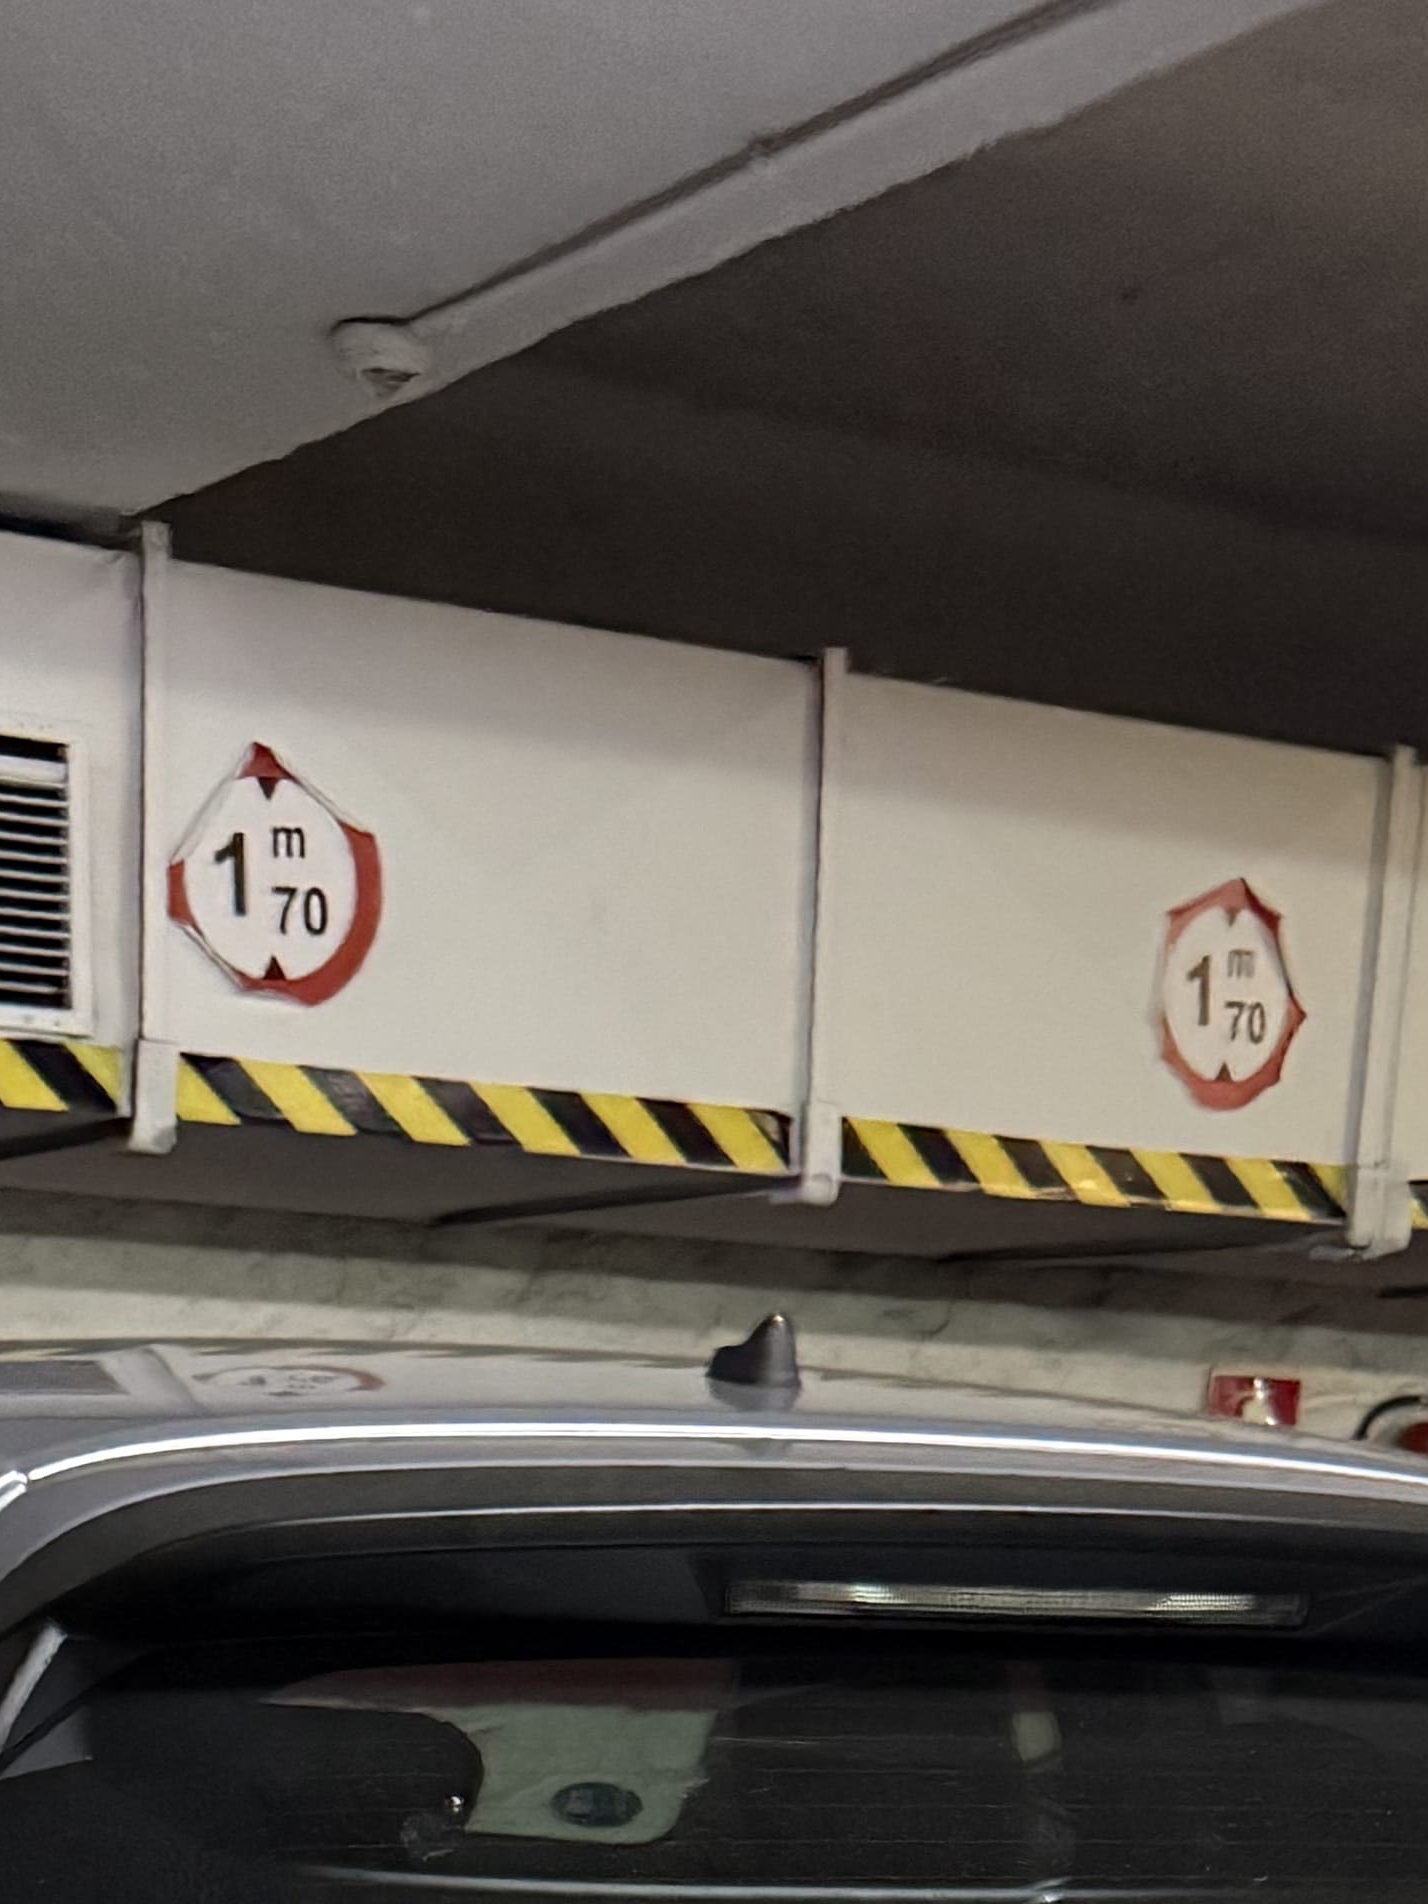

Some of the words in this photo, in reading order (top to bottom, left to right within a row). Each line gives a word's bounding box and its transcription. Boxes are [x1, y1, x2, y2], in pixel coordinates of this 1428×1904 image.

[214, 832, 246, 917] 1
[272, 826, 305, 859] m
[272, 886, 328, 936] 70
[1186, 954, 1211, 1027] 1
[1227, 949, 1256, 979] m
[1224, 1001, 1266, 1045] 70
